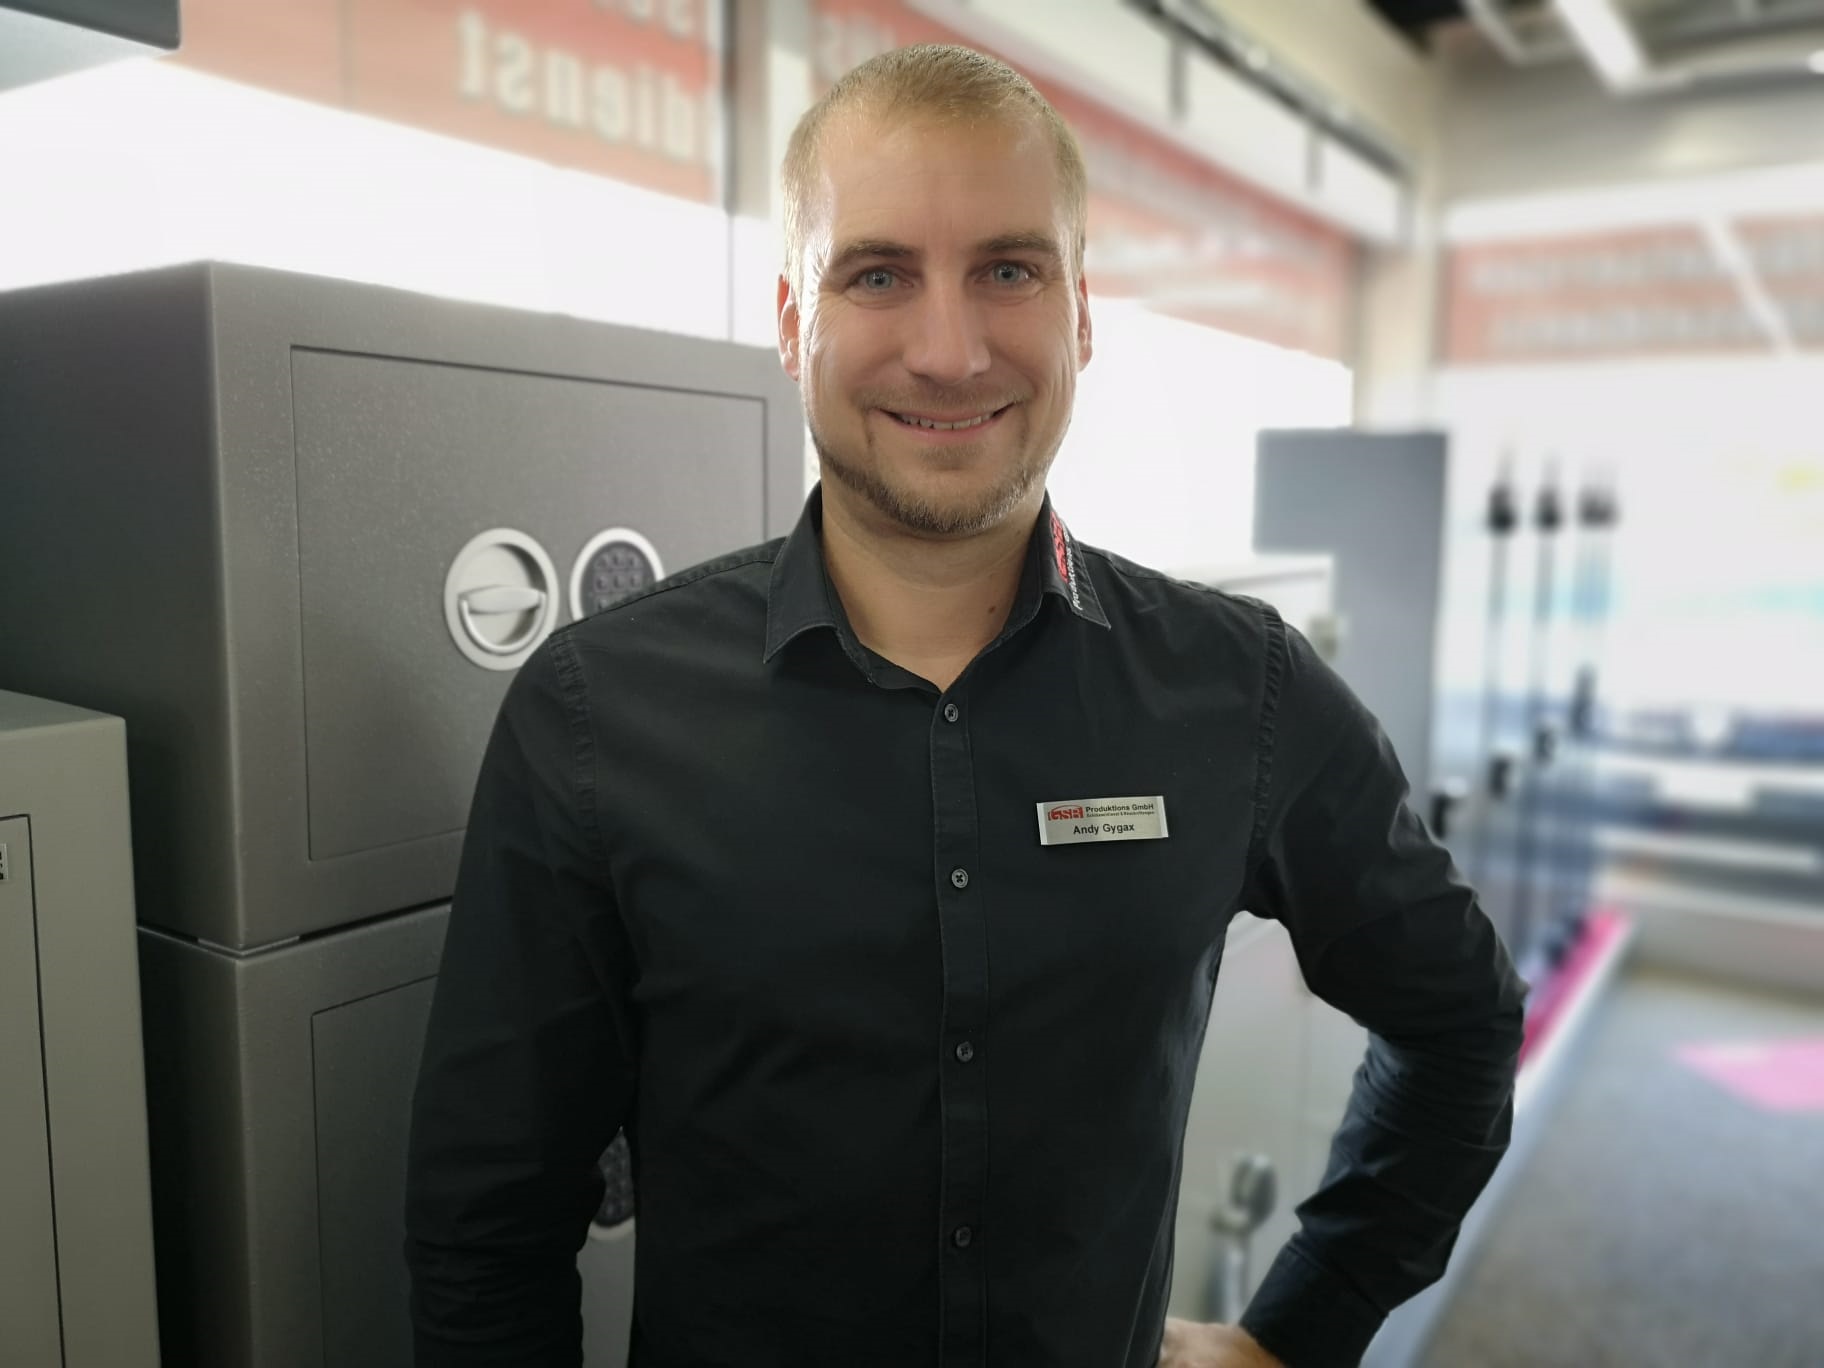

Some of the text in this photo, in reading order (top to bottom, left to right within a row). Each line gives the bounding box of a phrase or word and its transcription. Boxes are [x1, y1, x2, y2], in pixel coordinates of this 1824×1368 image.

[1085, 803, 1154, 813] Produktions GmbH
[1073, 823, 1135, 835] Andy Gygax
